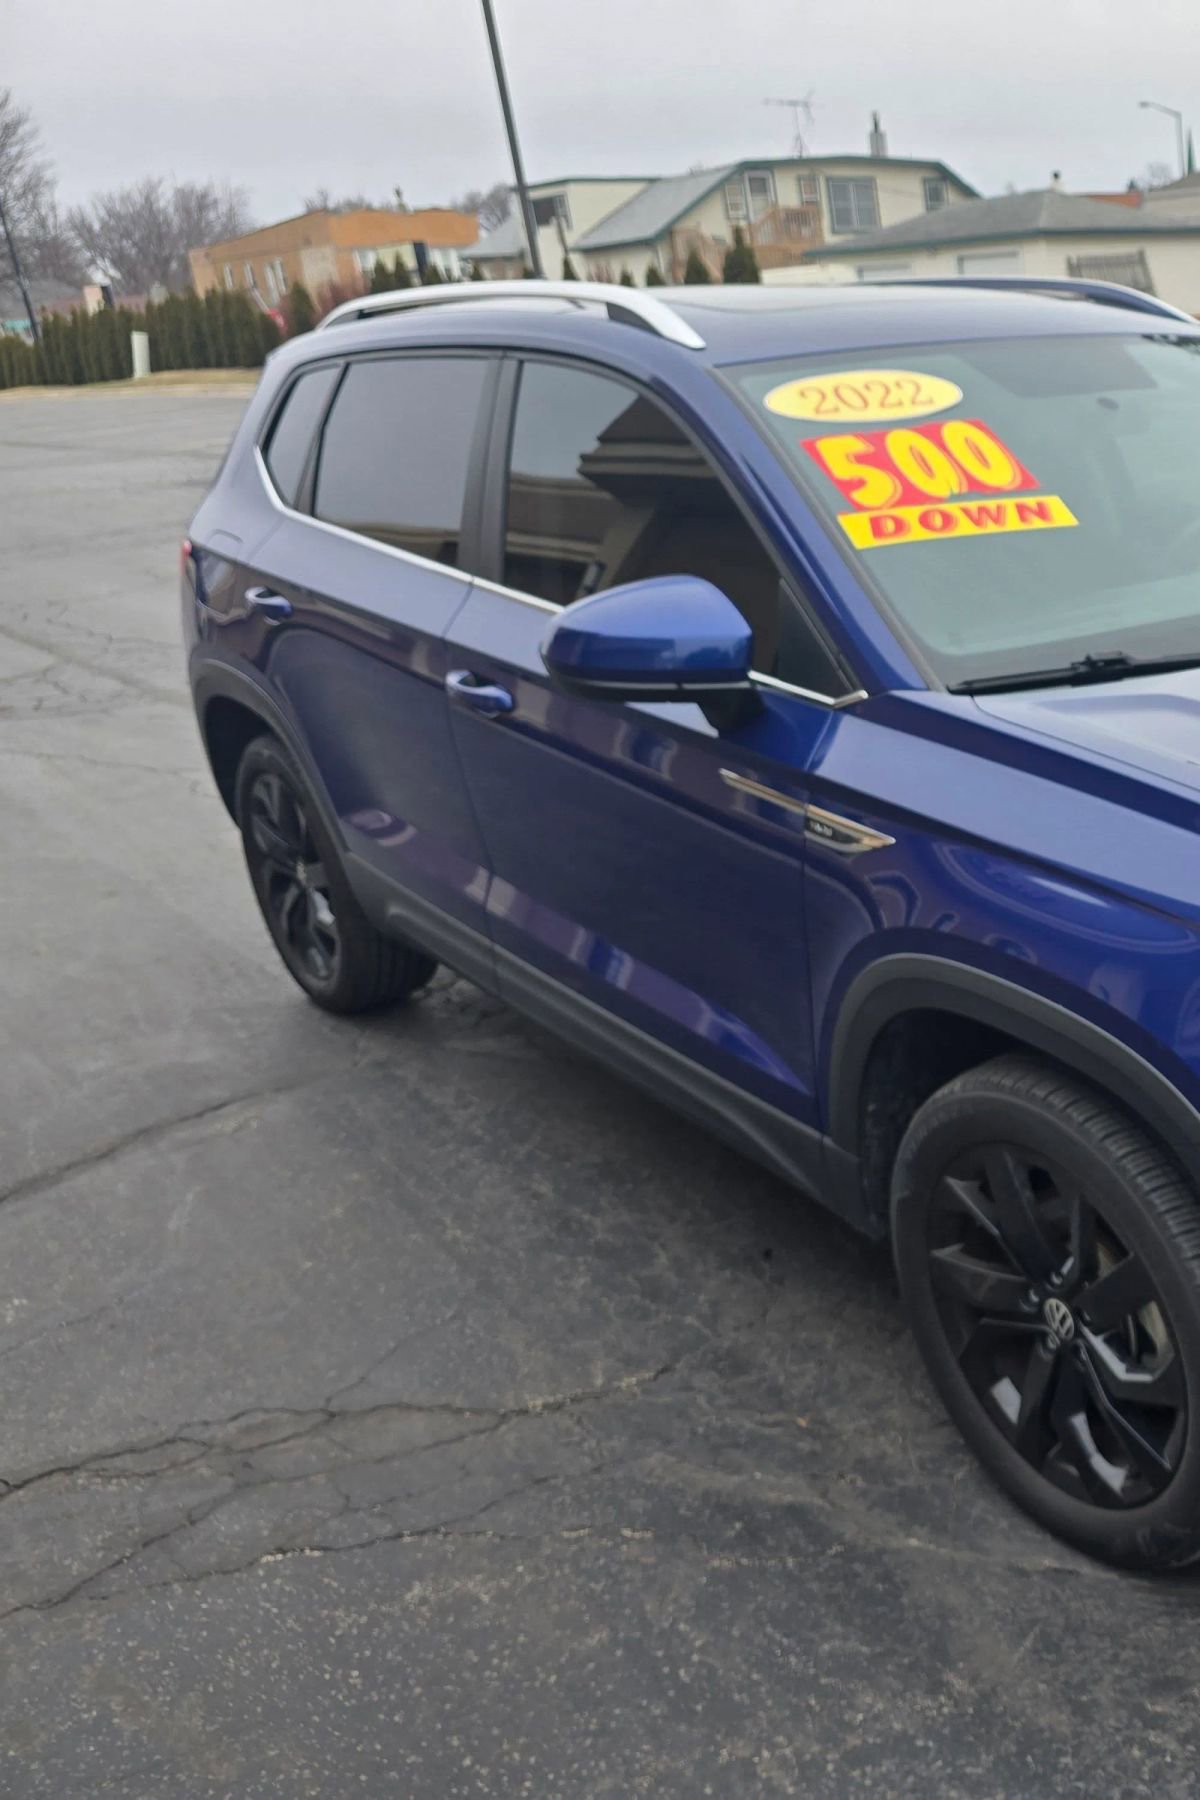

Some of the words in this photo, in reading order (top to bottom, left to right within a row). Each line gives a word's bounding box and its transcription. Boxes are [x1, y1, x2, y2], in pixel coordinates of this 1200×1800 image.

[800, 379, 934, 415] 2022
[816, 420, 1023, 509] 500
[869, 501, 1054, 540] DOWN
